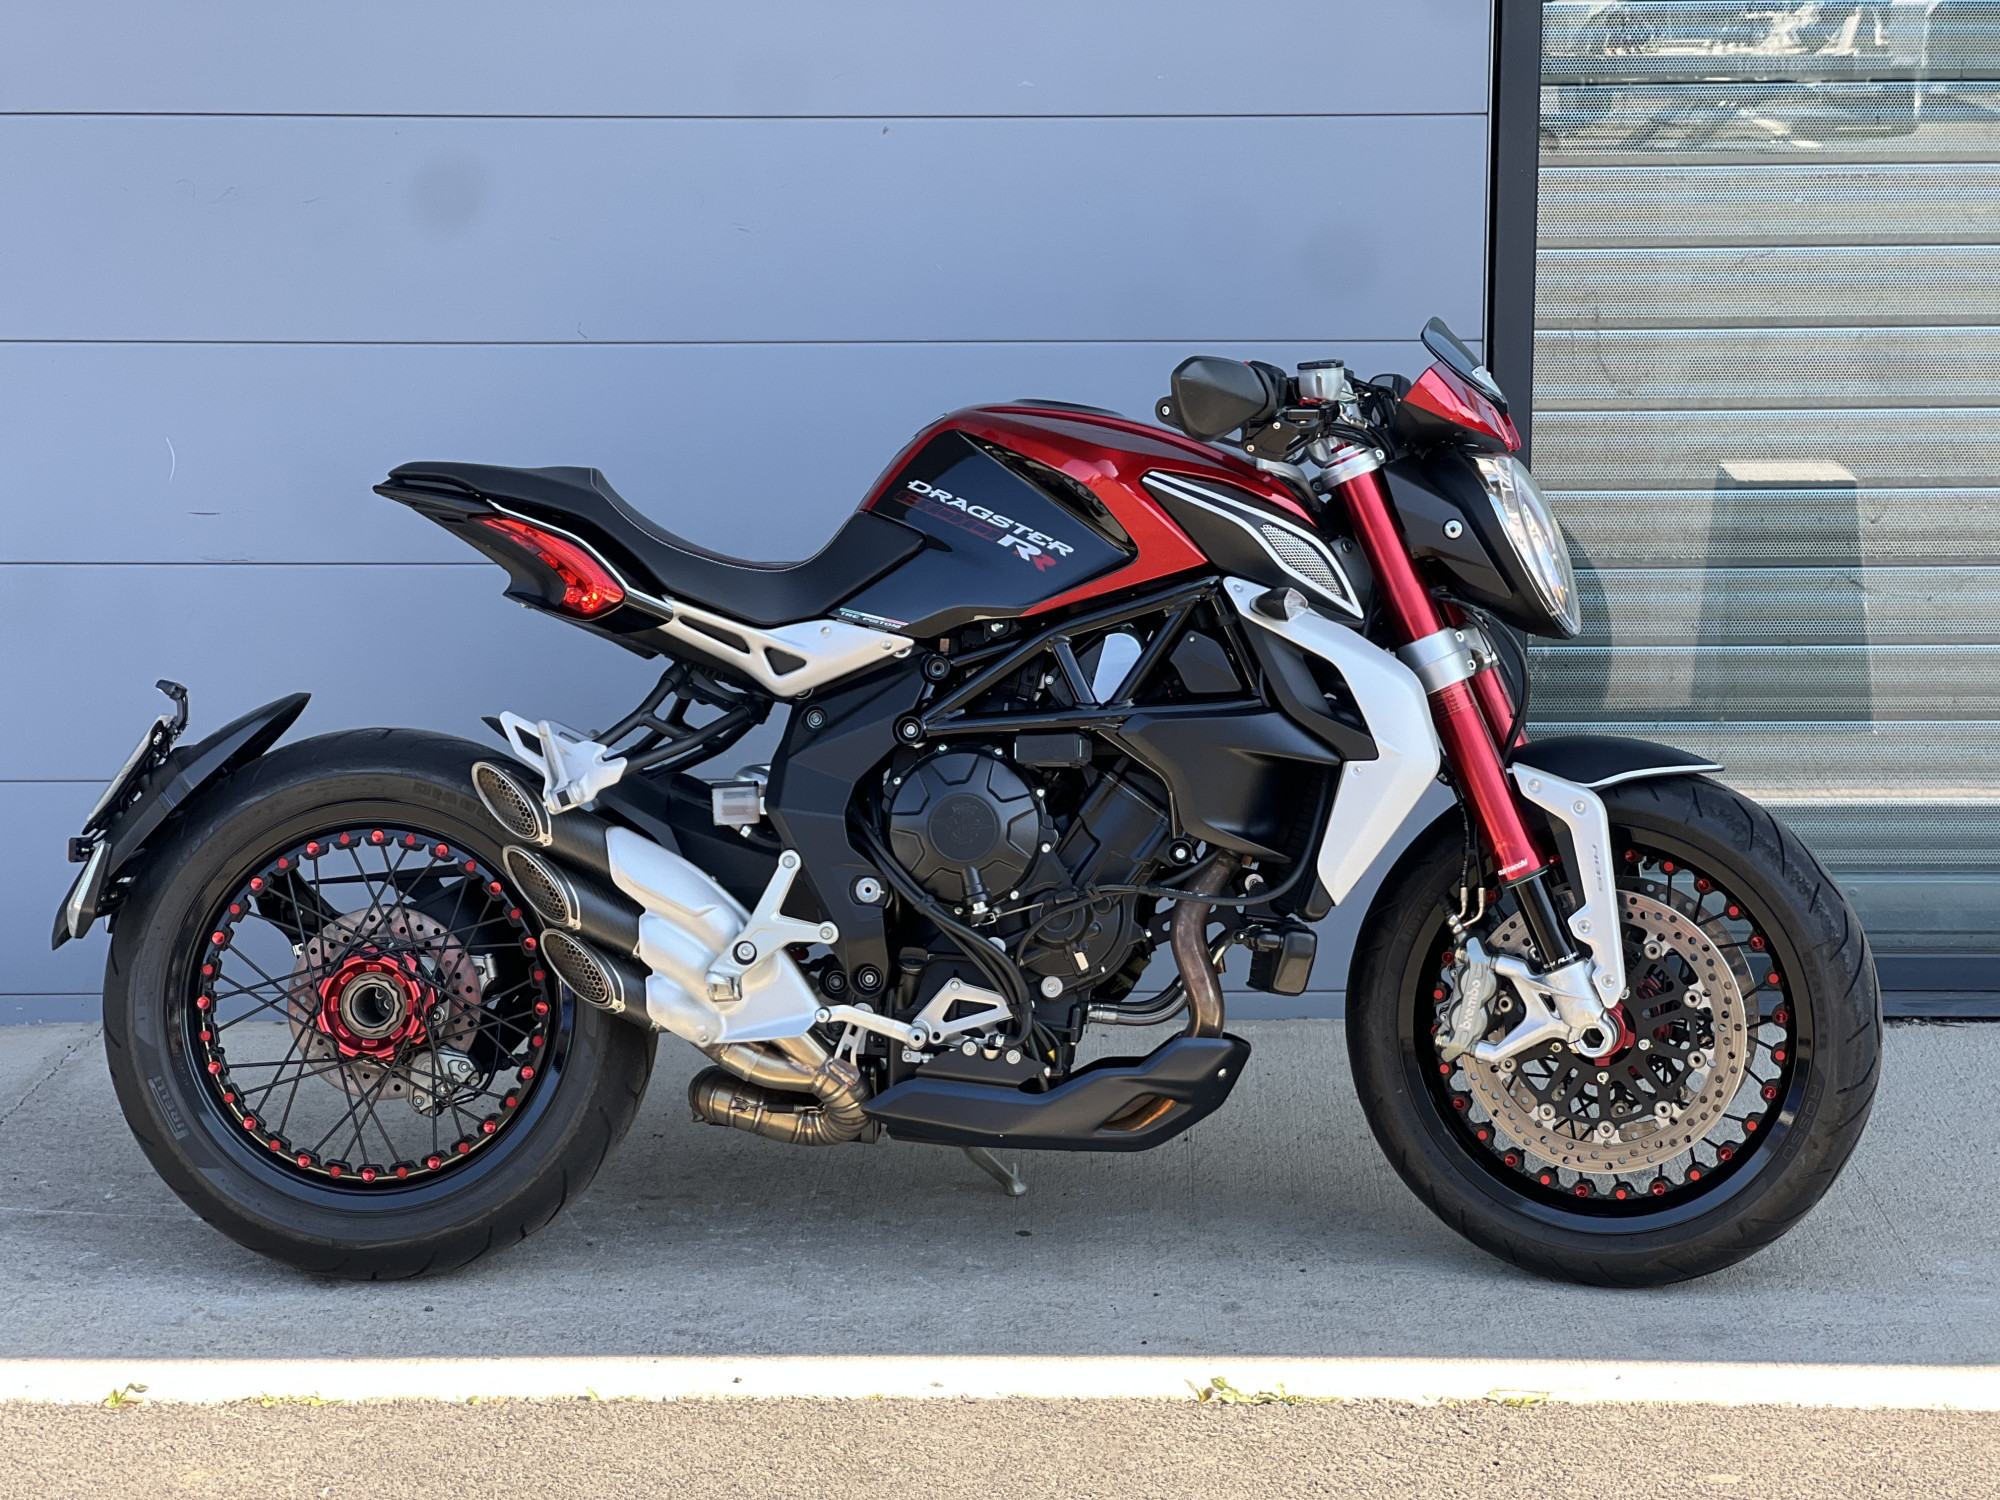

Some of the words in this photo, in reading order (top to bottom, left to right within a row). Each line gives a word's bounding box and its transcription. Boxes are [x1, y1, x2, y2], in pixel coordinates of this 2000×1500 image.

[894, 490, 1004, 542] 800
[997, 533, 1057, 572] RR
[907, 479, 1075, 557] DRAGSTER
[840, 611, 860, 619] TRE
[1459, 979, 1481, 1031] brembo
[148, 1076, 189, 1140] PIRELLI
[1782, 1084, 1822, 1161] ROSSO
